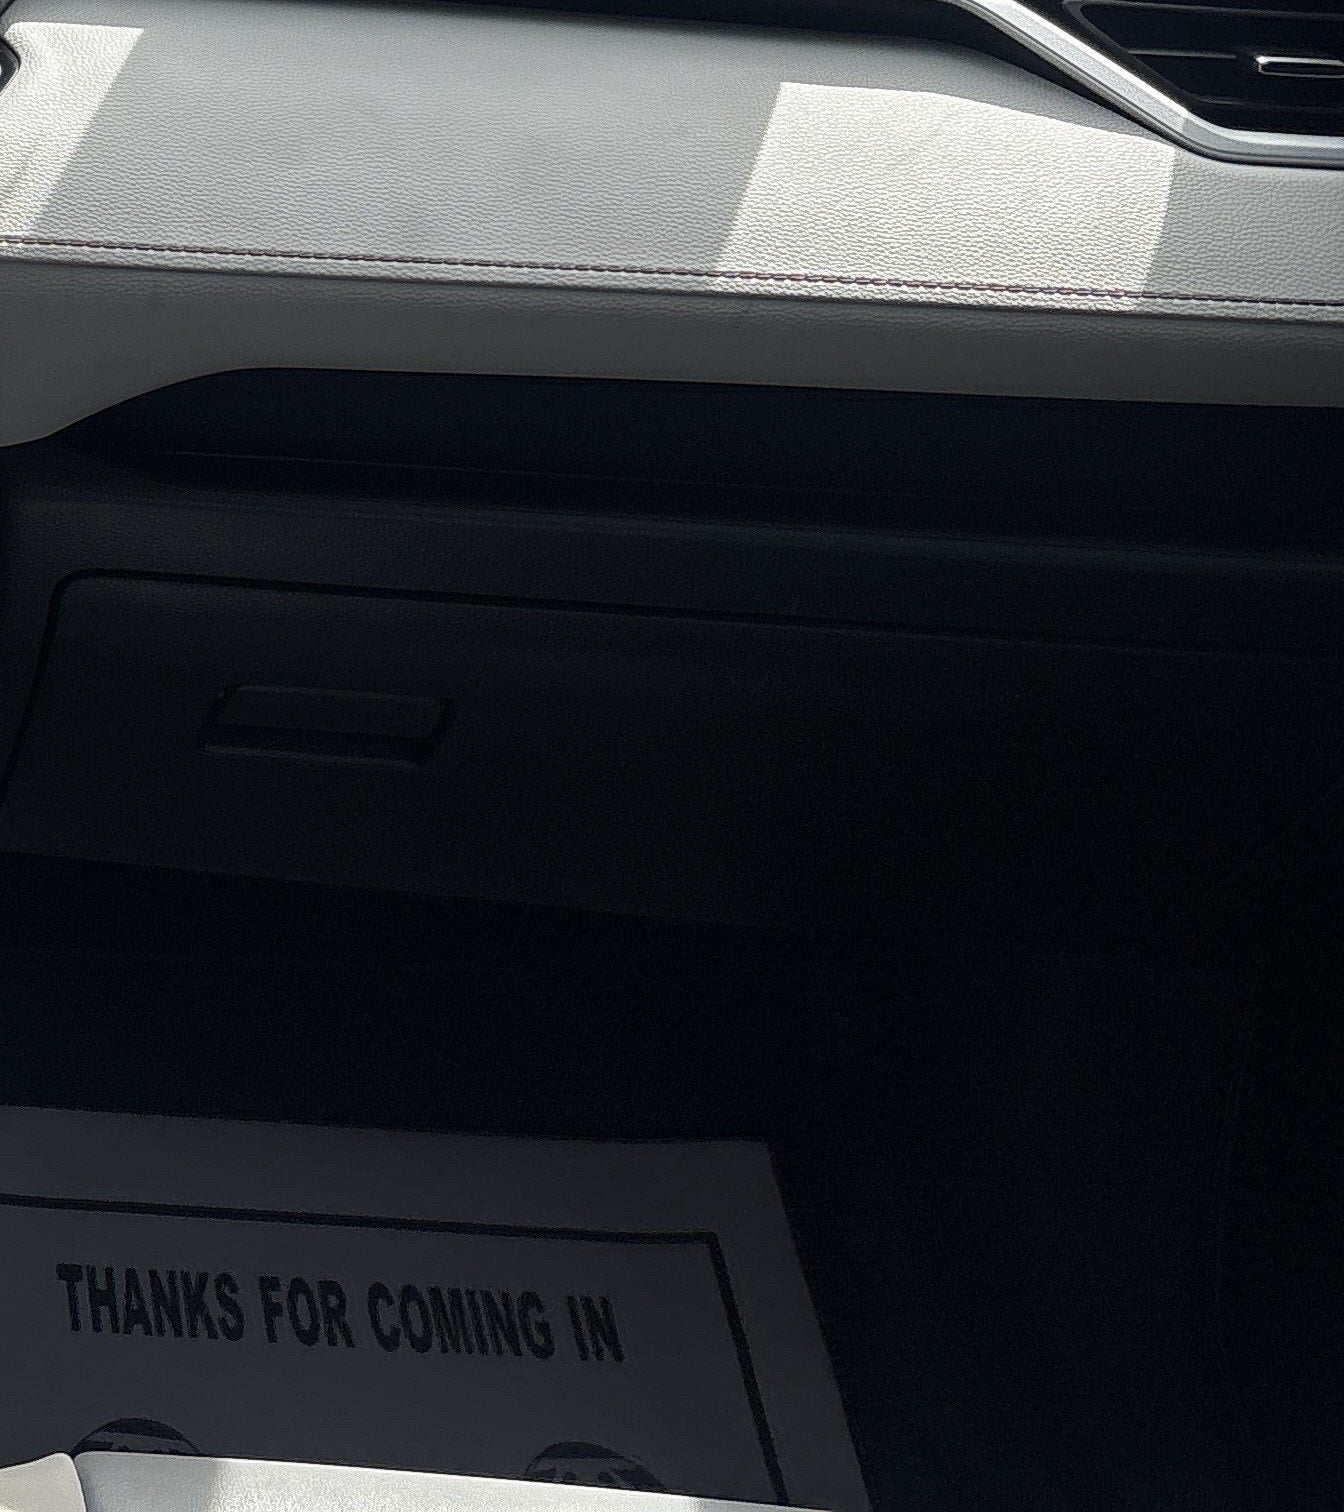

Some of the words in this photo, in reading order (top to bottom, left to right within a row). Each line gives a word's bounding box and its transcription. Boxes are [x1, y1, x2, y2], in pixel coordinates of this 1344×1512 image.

[56, 1262, 245, 1343] THANKS
[258, 1275, 358, 1350] FOR
[368, 1281, 556, 1363] COMING
[568, 1294, 625, 1365] IN
